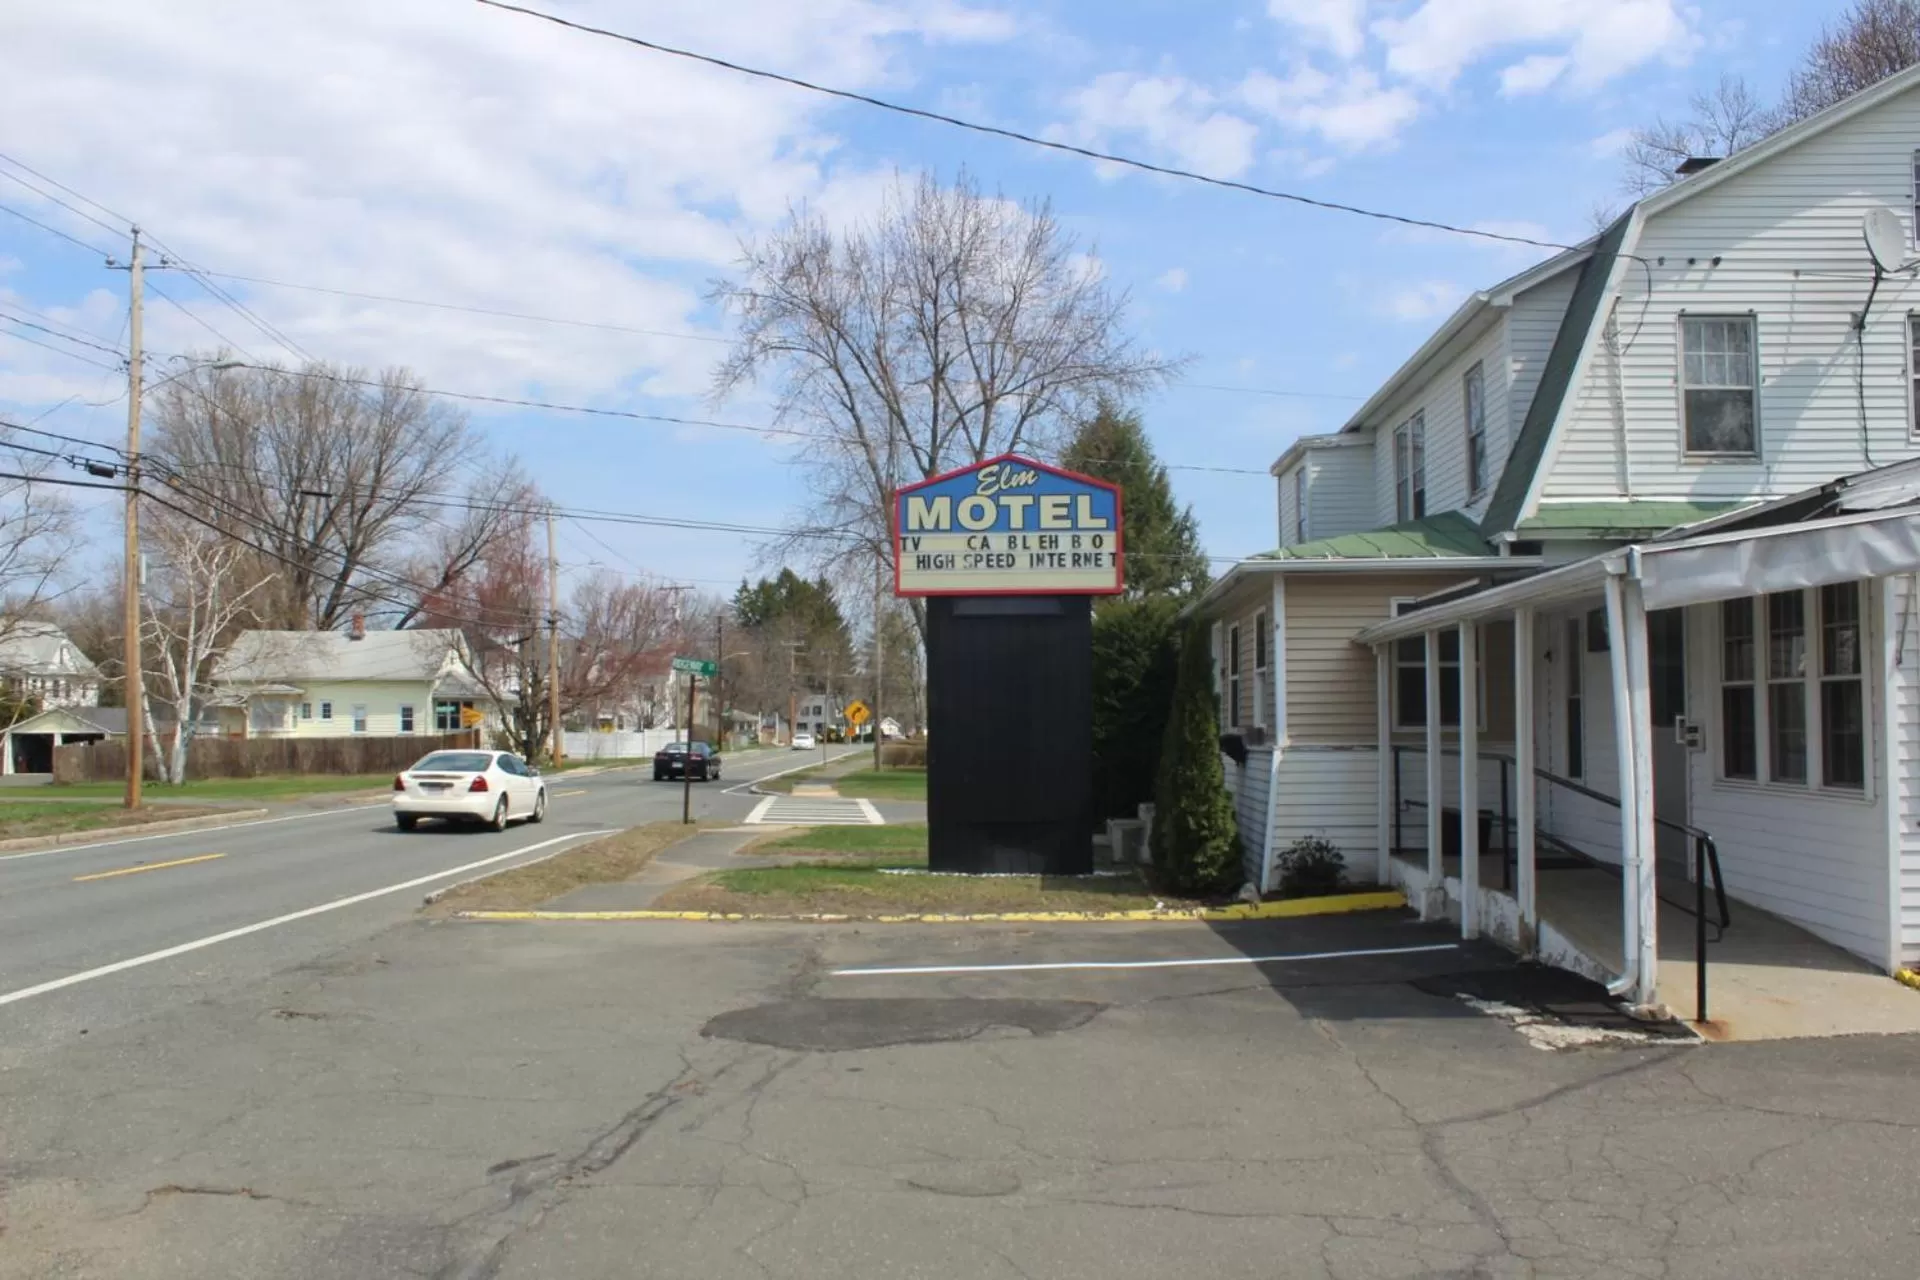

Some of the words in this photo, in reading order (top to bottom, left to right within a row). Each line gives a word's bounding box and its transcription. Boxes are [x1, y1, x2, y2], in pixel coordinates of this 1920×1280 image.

[976, 464, 1039, 496] Elm
[906, 494, 1108, 532] MOTEL
[901, 536, 921, 552] TV
[916, 554, 956, 571] HIGH
[963, 553, 1016, 570] SPEED
[1029, 552, 1118, 569] INTERNET
